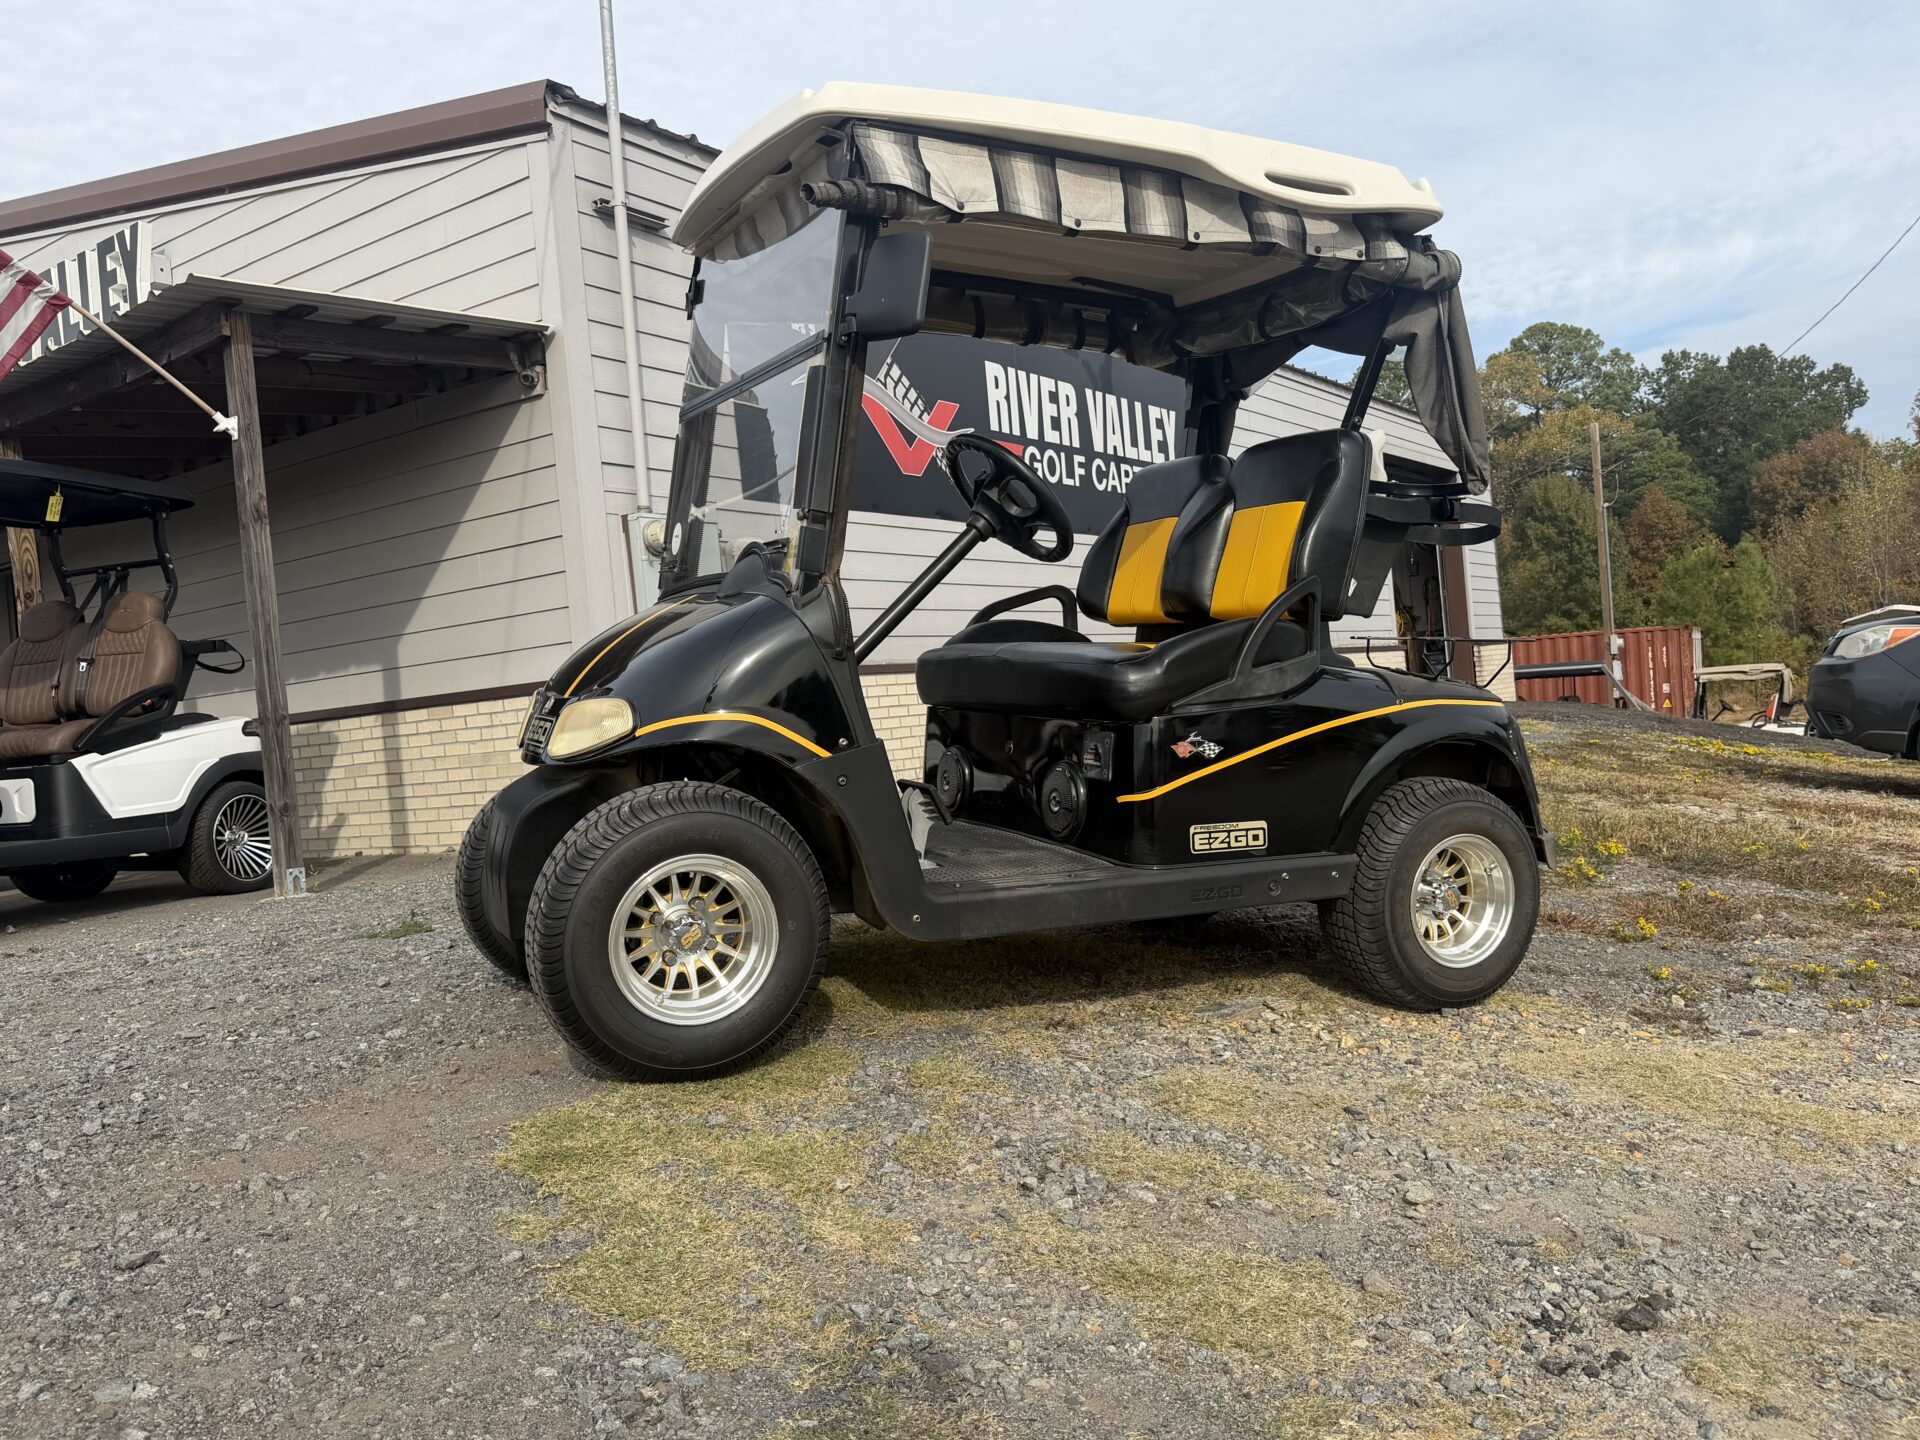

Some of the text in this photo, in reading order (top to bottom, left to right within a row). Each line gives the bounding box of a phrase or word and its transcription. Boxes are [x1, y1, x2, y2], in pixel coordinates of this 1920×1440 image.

[18, 221, 141, 362] ALLEY
[984, 360, 1176, 464] RIVER VALLEY
[1024, 445, 1144, 494] GOLF CAR
[1193, 823, 1239, 832] FREEDOM
[1193, 829, 1265, 850] EZGO
[1191, 885, 1245, 904] EZGO
